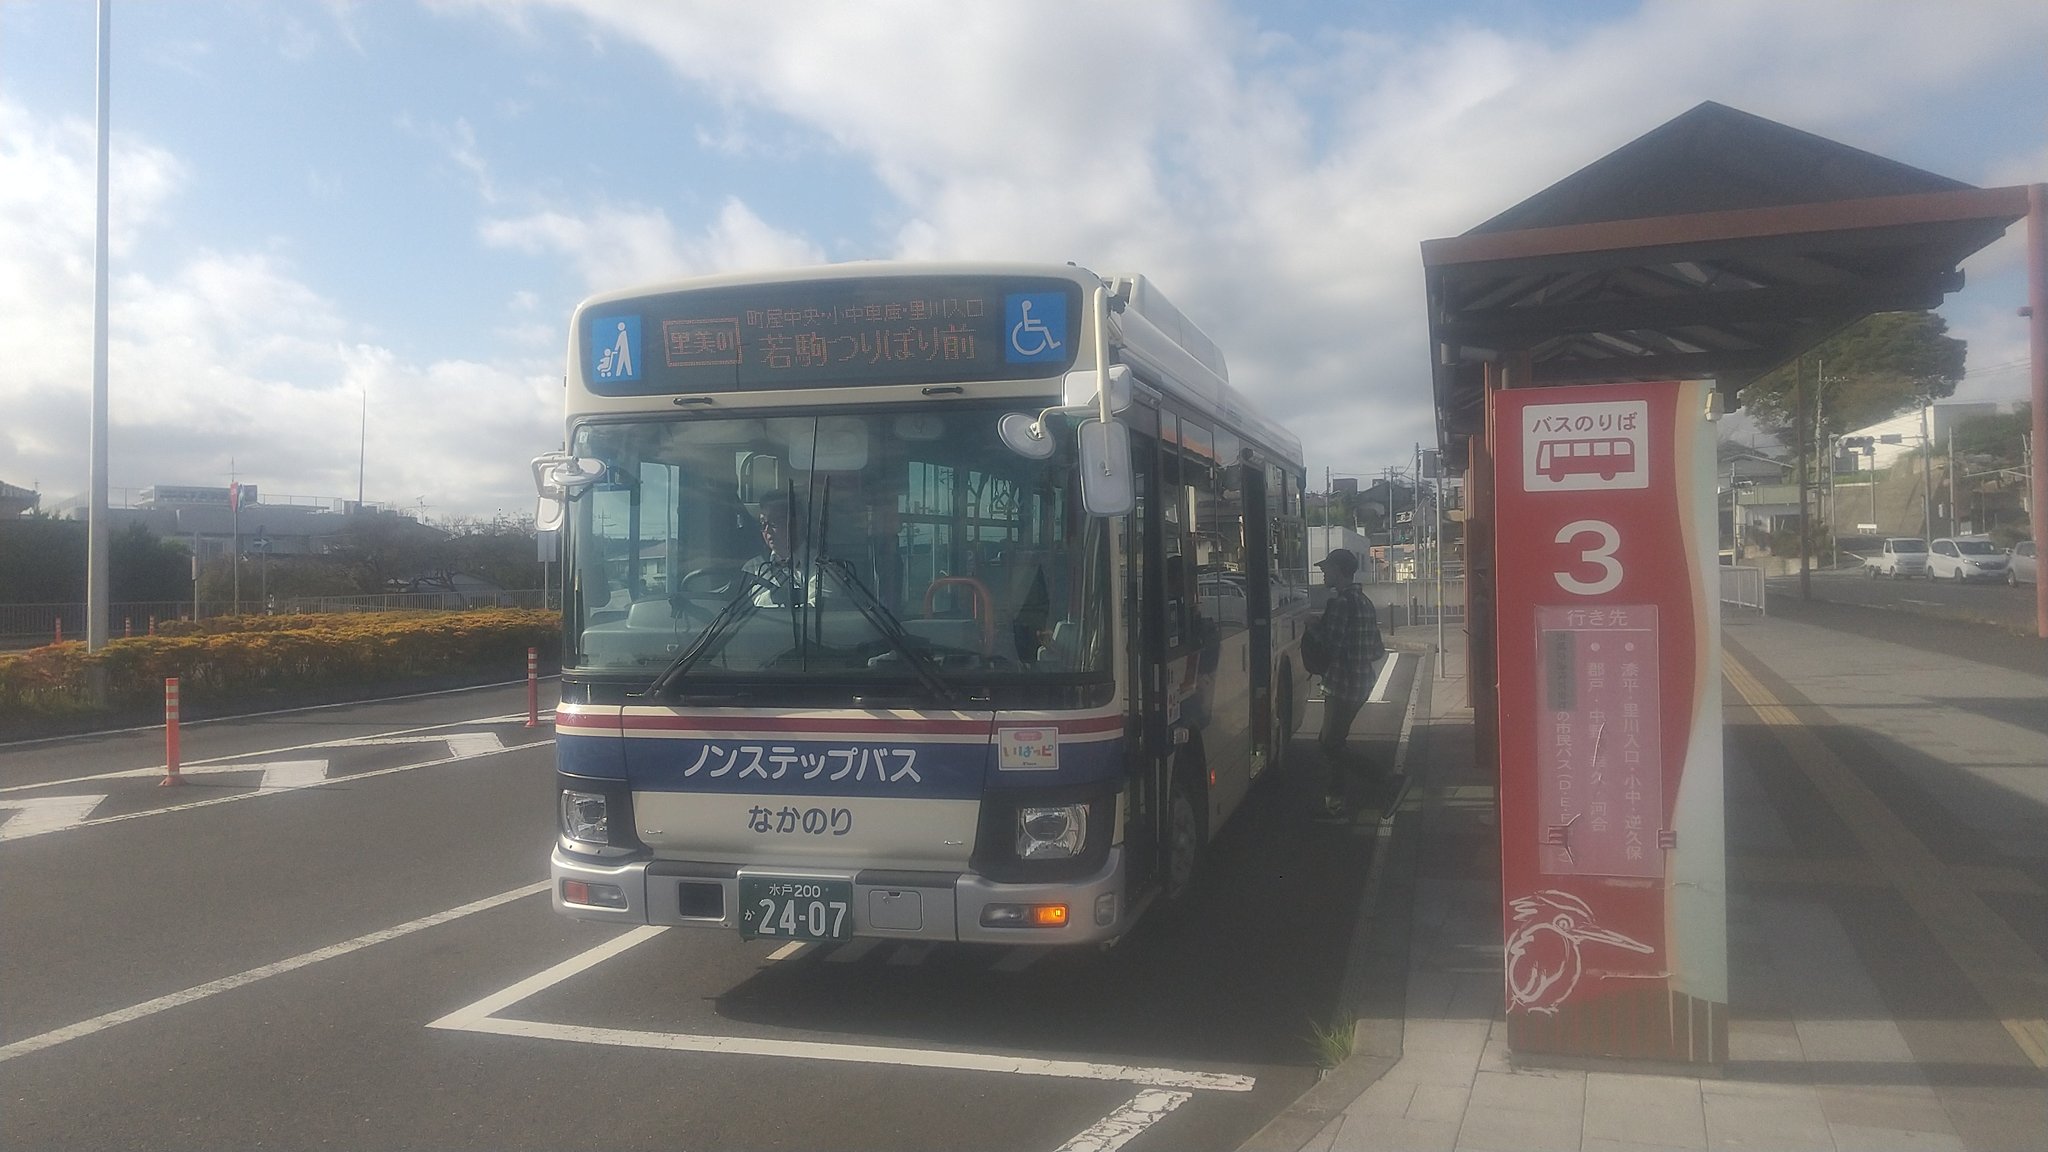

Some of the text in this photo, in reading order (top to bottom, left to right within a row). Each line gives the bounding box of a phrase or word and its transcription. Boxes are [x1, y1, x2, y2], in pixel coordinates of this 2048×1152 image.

[1532, 411, 1637, 433] バスのりば
[1554, 519, 1624, 595] 3
[1567, 609, 1628, 628] 行き先
[684, 745, 921, 783] ノンステップバス
[747, 805, 853, 836] なかのり
[769, 884, 821, 898] 水戸200
[744, 898, 847, 938] か 24-07
